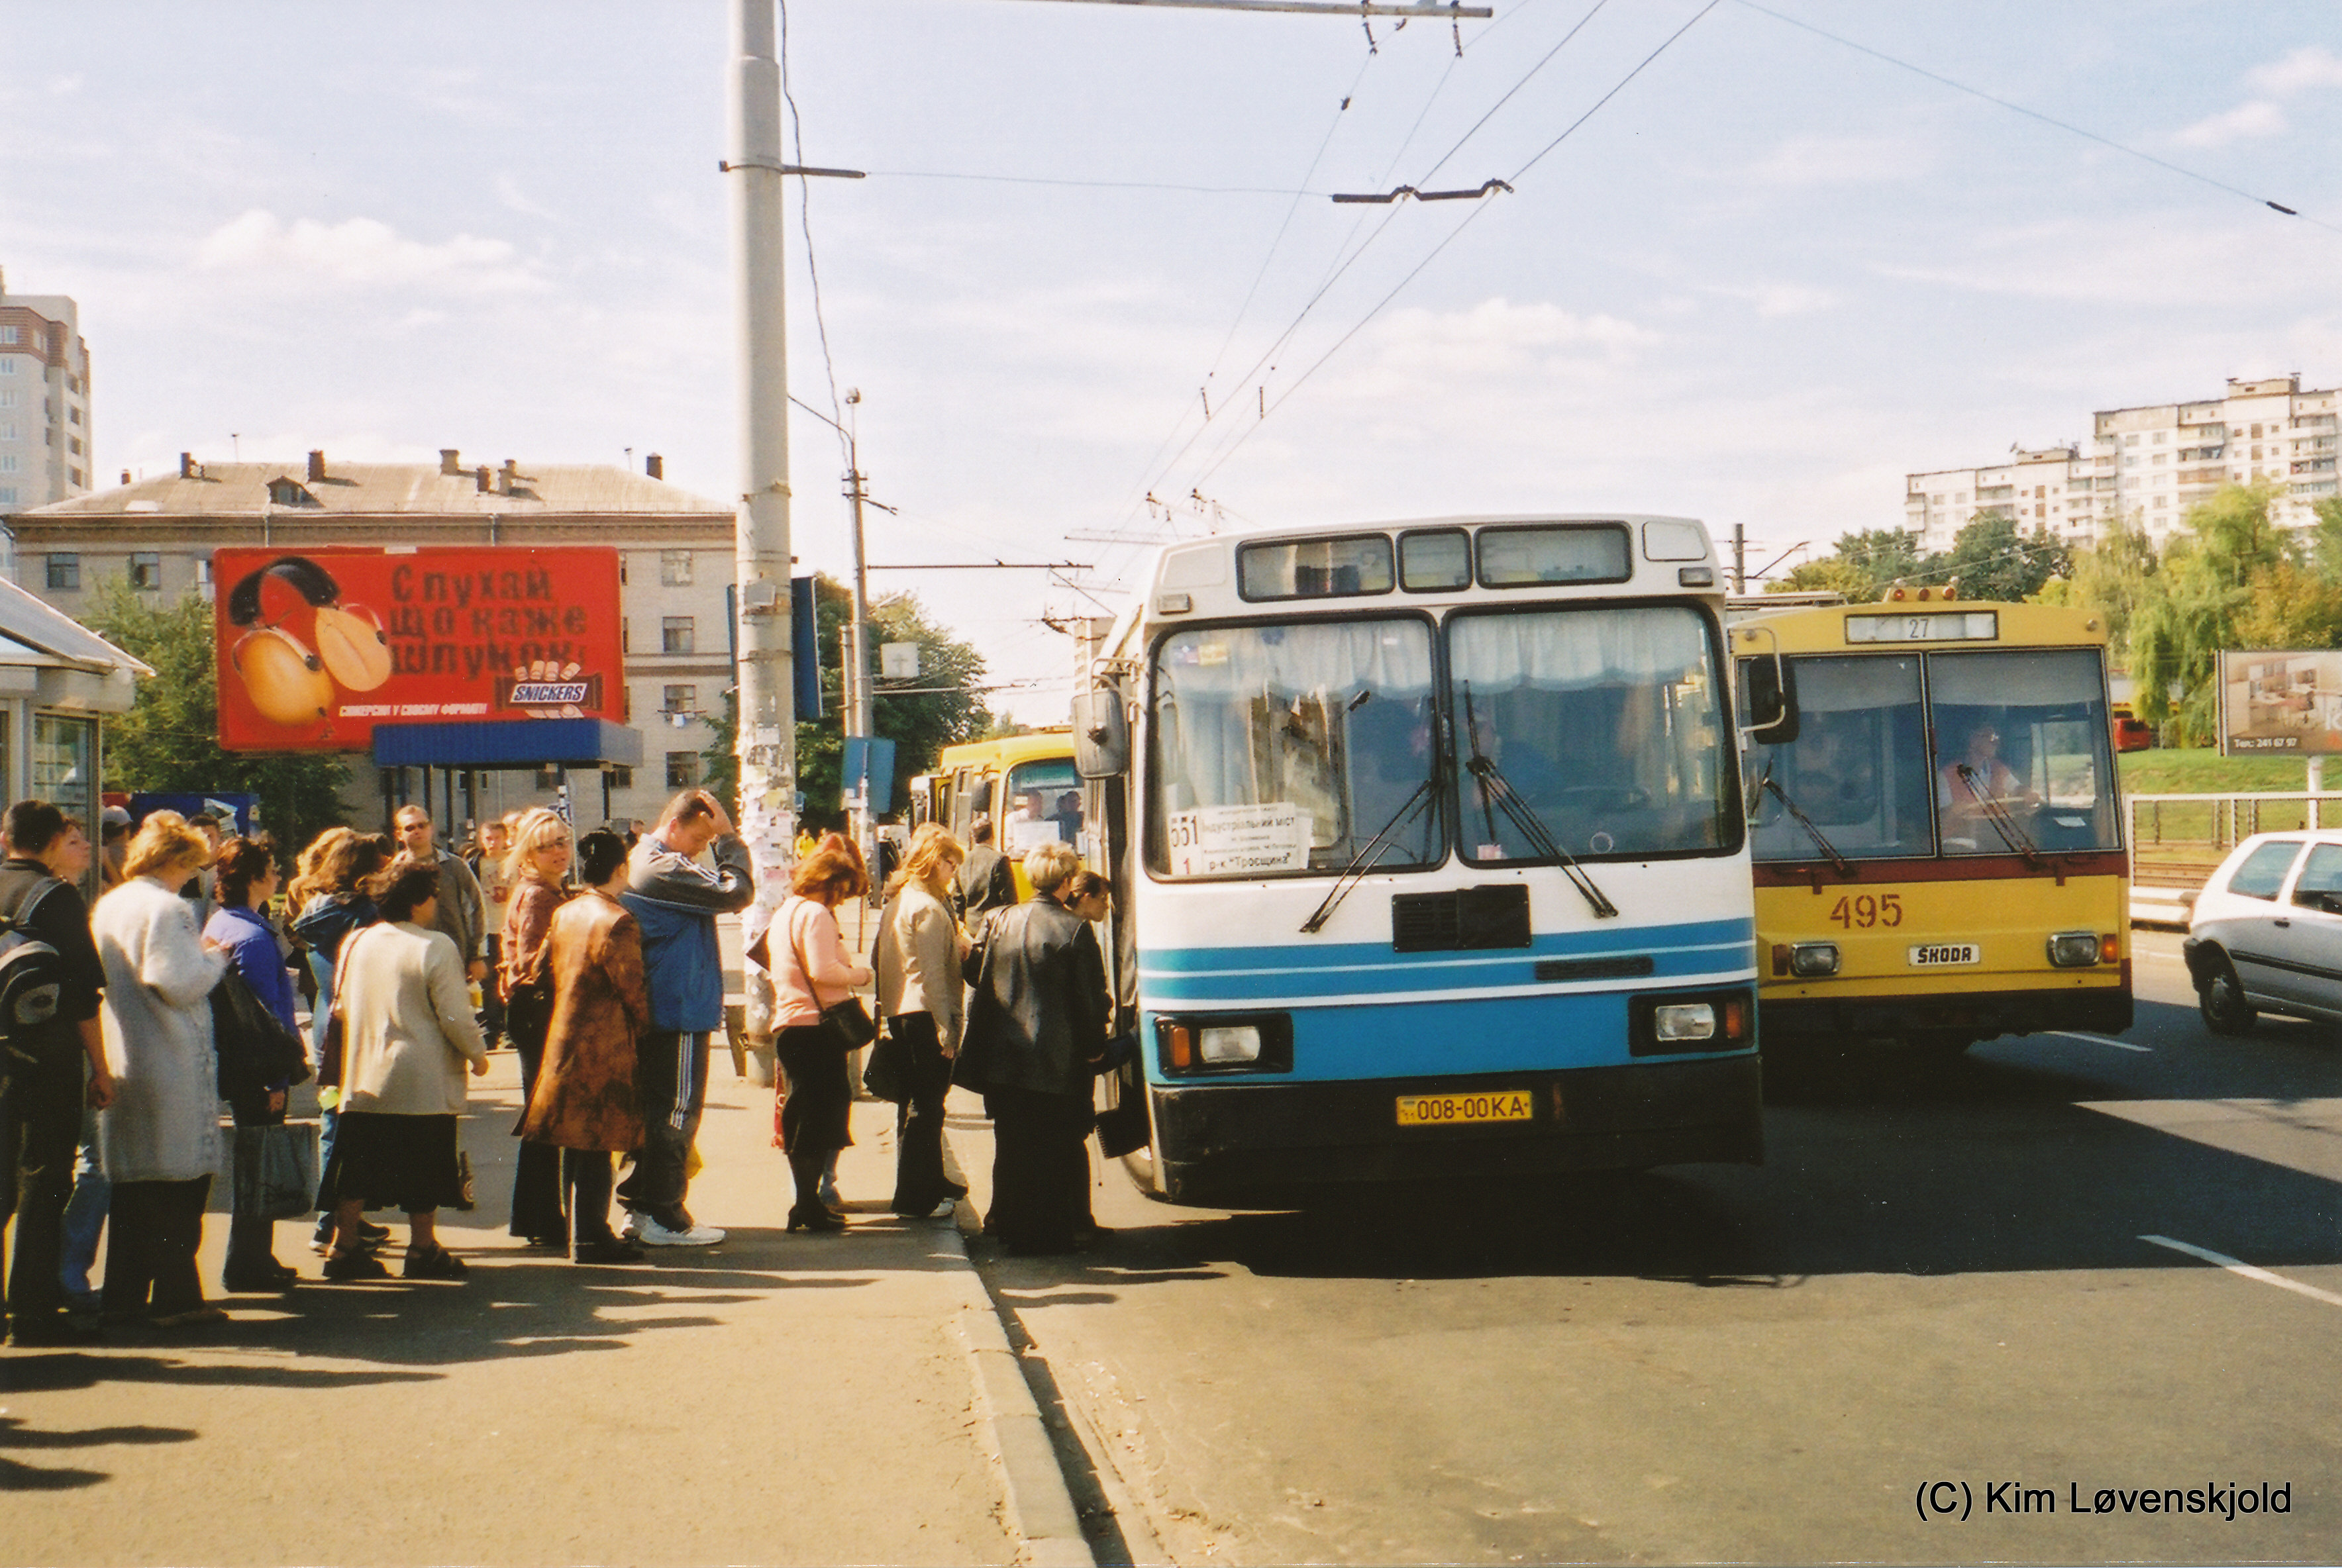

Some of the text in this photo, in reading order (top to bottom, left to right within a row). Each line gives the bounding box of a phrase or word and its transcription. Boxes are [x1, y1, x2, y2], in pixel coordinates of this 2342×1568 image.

[471, 605, 587, 638] каже
[1909, 618, 1929, 639] 27
[513, 685, 584, 701] SNICKERS
[1171, 815, 1199, 848] 551
[1830, 894, 1902, 928] 495
